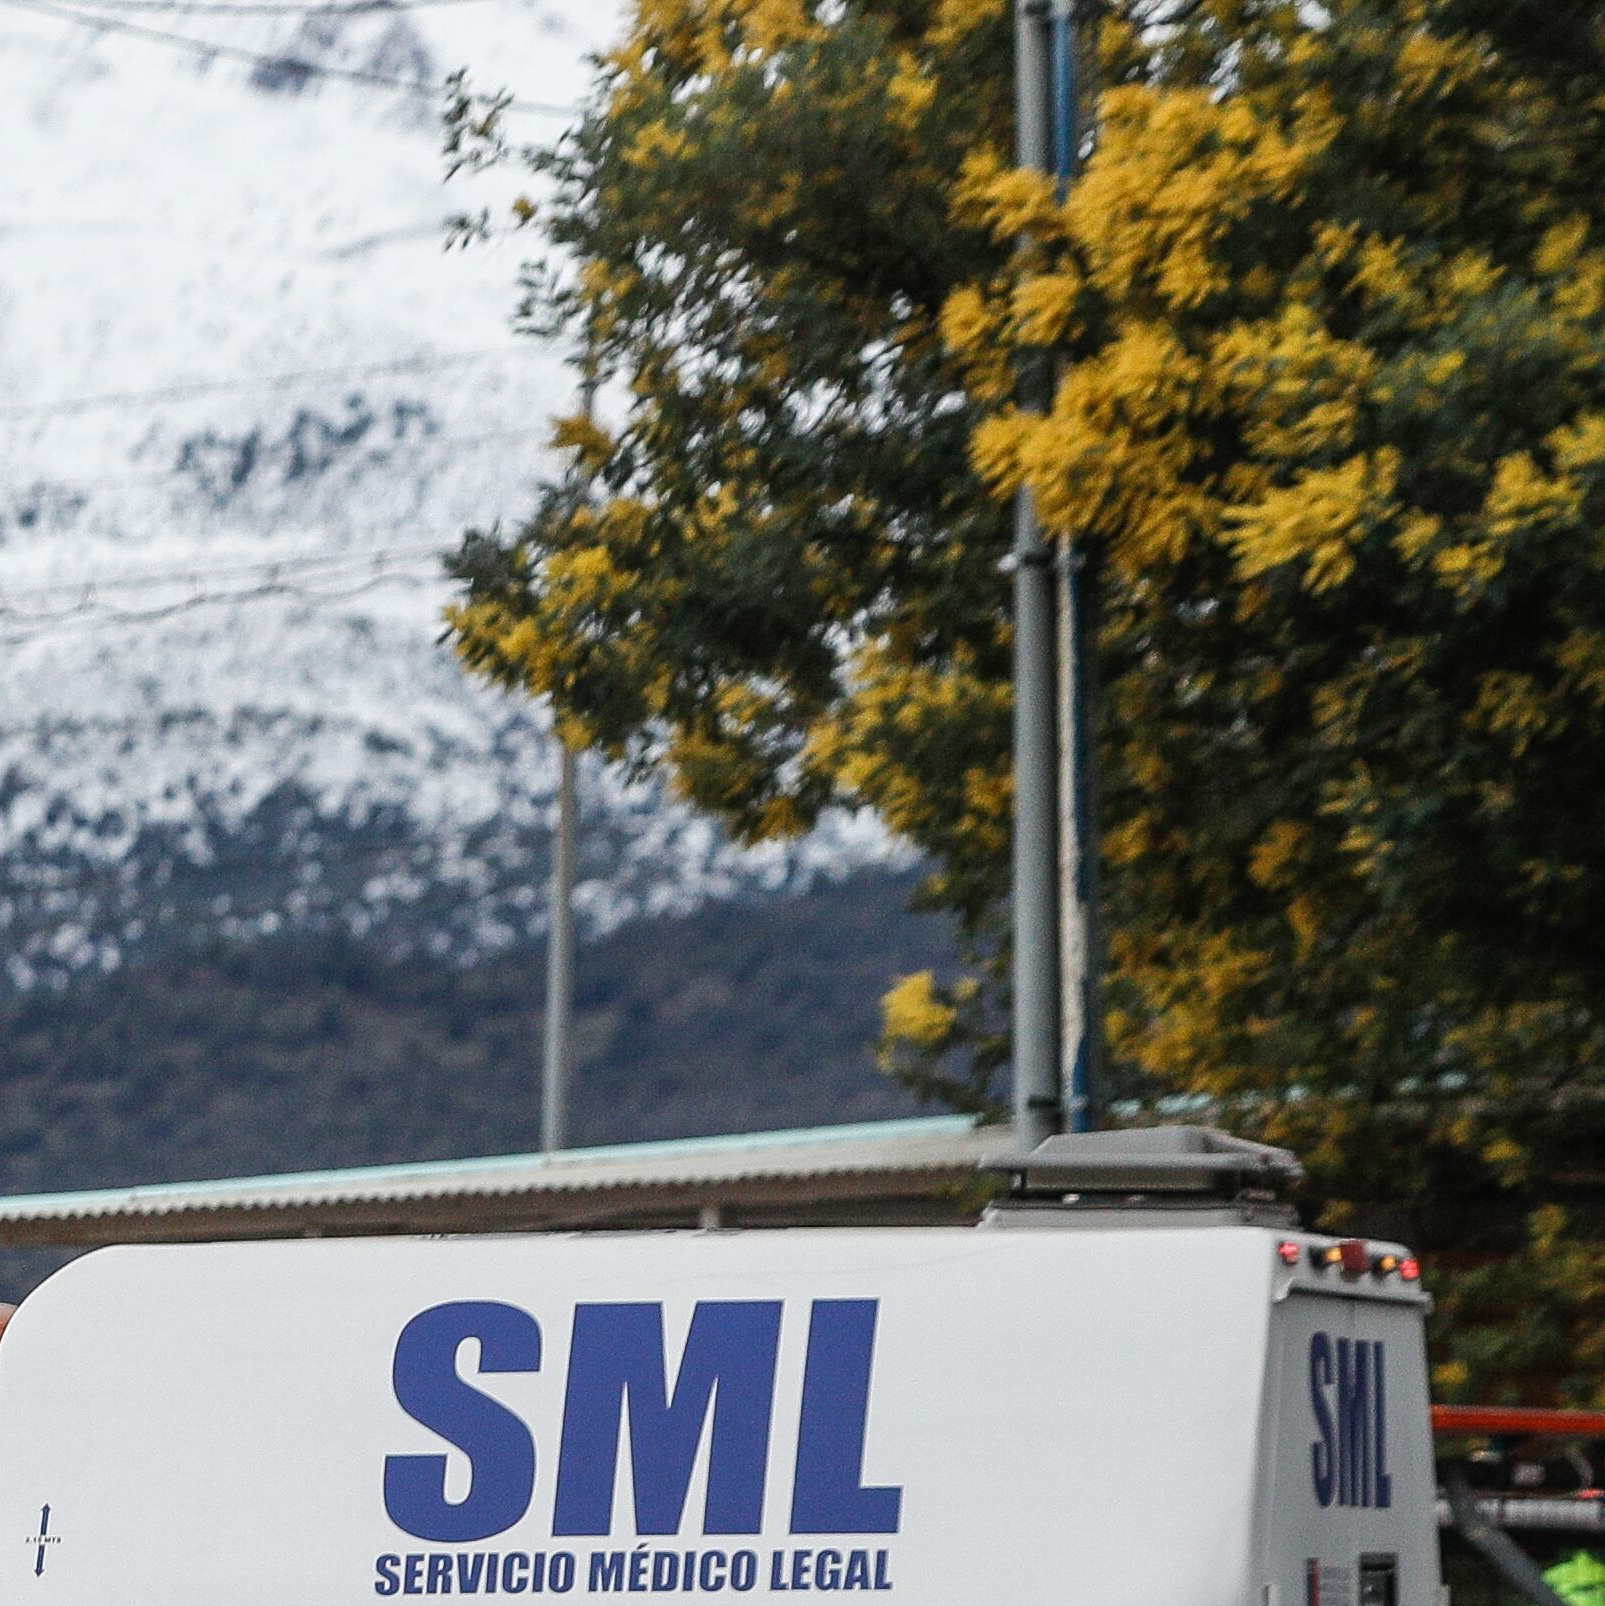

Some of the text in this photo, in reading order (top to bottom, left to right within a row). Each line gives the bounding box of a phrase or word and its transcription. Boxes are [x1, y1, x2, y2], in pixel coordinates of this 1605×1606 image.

[383, 1298, 903, 1543] SML
[1310, 1331, 1391, 1508] SML
[375, 1544, 893, 1595] SERVICIO MÉDICO LEGAL
